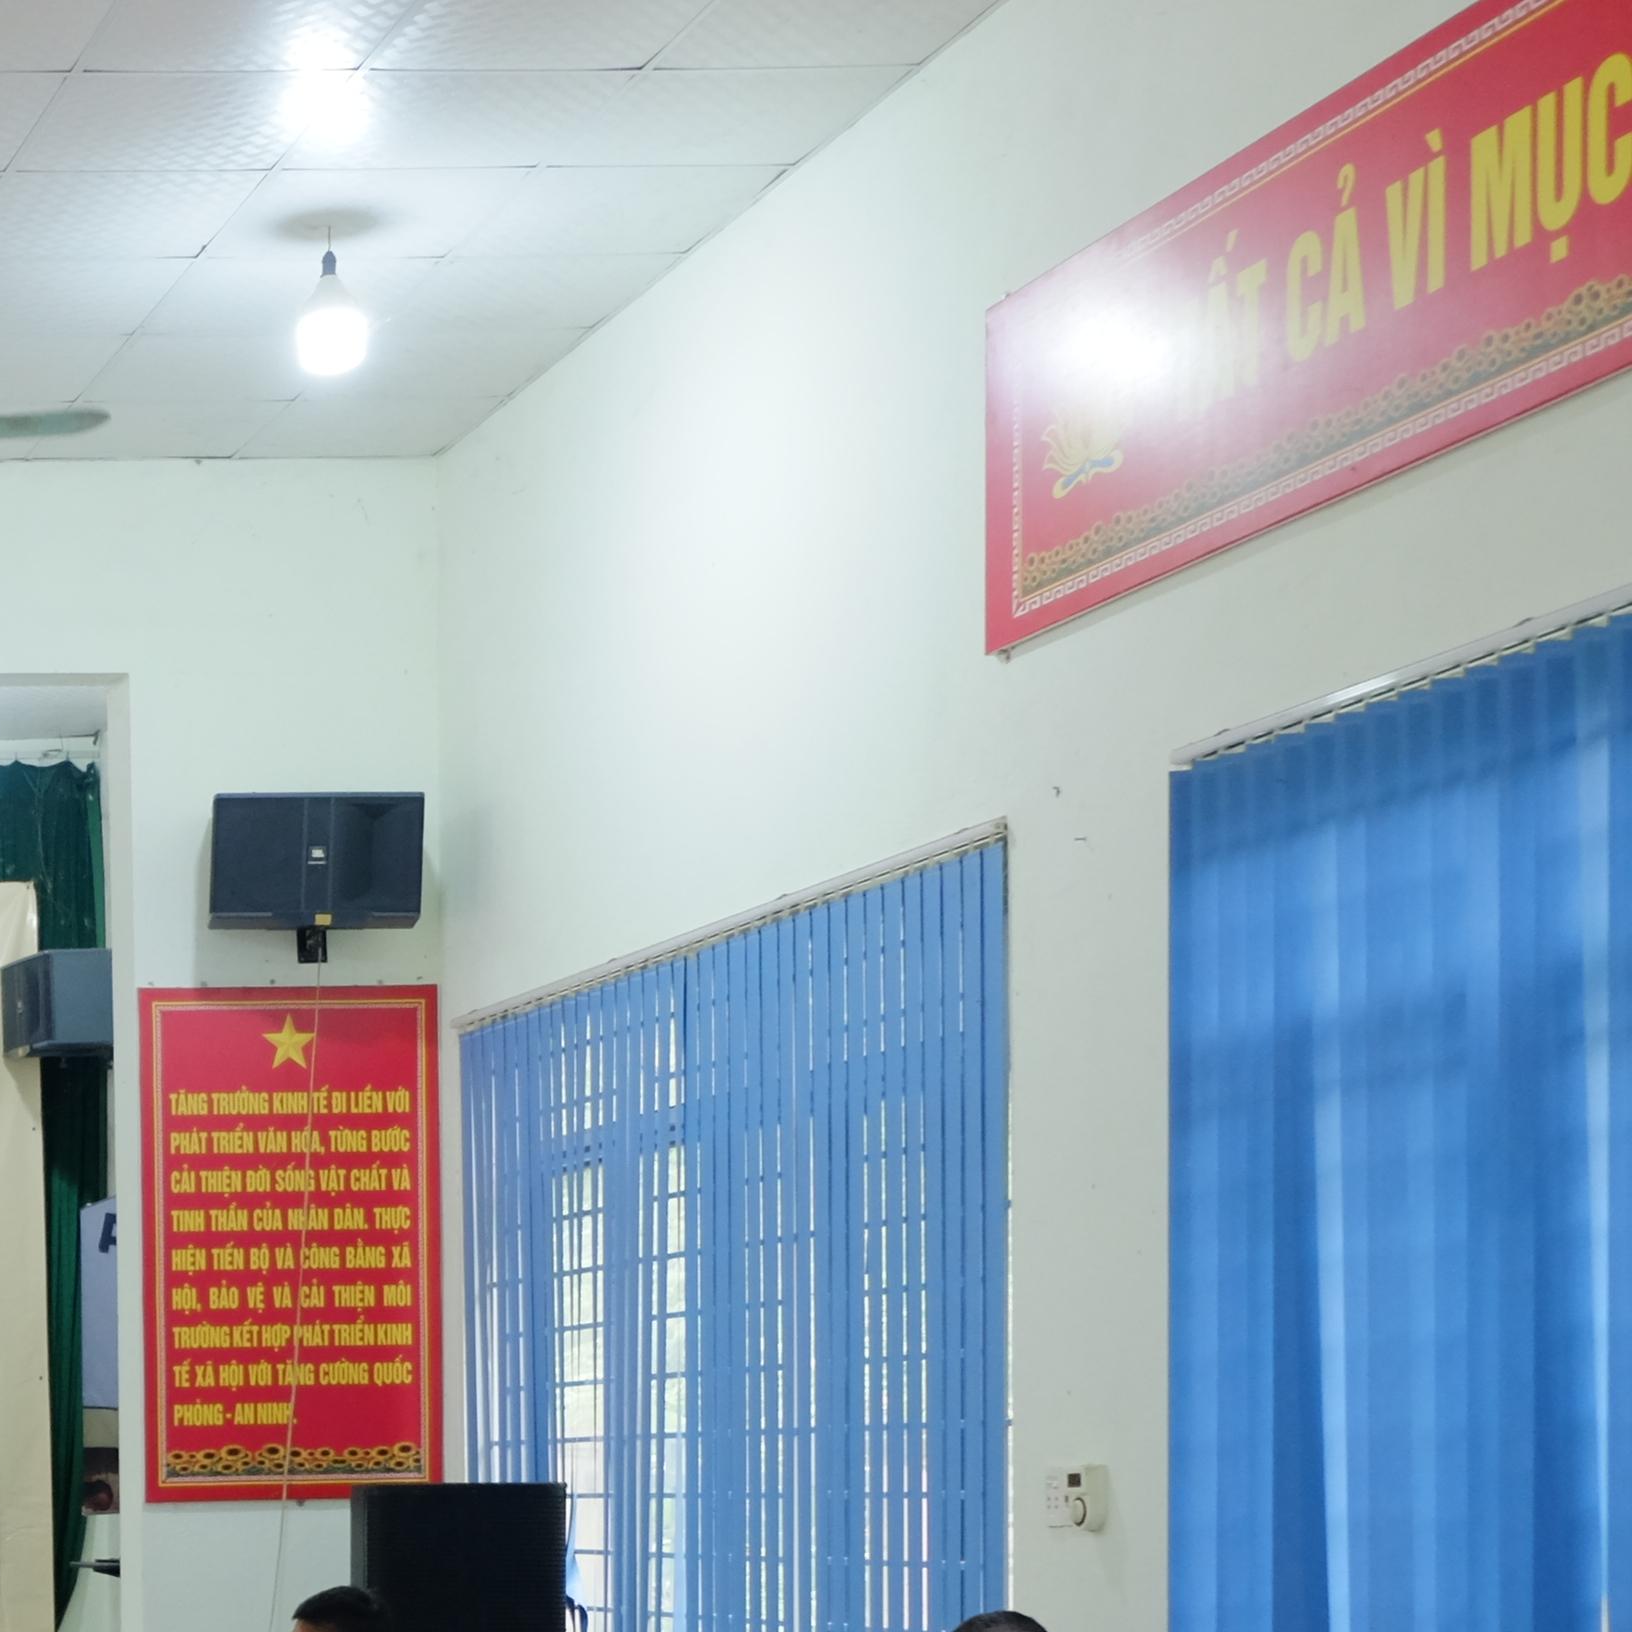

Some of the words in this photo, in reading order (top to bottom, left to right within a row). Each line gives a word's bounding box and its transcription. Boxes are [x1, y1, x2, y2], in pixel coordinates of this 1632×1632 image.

[1171, 229, 1267, 418] ẤT
[1286, 164, 1366, 362] CẢ
[1386, 129, 1447, 310] VÌ
[170, 1089, 208, 1115] TĂNG
[211, 1086, 268, 1115] TRƯỞNG
[273, 1092, 311, 1116] KINH
[313, 1086, 329, 1113] TẾ
[331, 1092, 346, 1113] ĐI
[350, 1086, 382, 1113] LIỀN
[386, 1088, 409, 1112] VỚI
[170, 1128, 207, 1154] PHÁT
[211, 1123, 253, 1153] TRIỂN
[258, 1128, 287, 1152] VĂN
[291, 1125, 325, 1155] HÓA,
[329, 1127, 367, 1152] TỪNG
[371, 1126, 410, 1152] BƯỚC
[171, 1165, 195, 1193] CẢI
[200, 1167, 242, 1196] THIỆN
[246, 1166, 270, 1192] ĐỜI
[275, 1162, 315, 1195] SỐNG
[320, 1165, 345, 1195] VẬT
[350, 1165, 387, 1190] CHẤT
[392, 1165, 411, 1190] VÀ
[171, 1210, 205, 1231] TINH
[209, 1203, 248, 1231] THẦN
[253, 1203, 283, 1230] CỦA
[288, 1205, 328, 1231] NHÂN
[334, 1204, 368, 1229] DÂN.
[374, 1206, 410, 1233] THỰC
[172, 1245, 206, 1274] HIỆN
[211, 1242, 244, 1270] TIẾN
[250, 1244, 269, 1273] BỘ
[276, 1244, 294, 1269] VÀ
[301, 1238, 340, 1268] CÔNG
[345, 1239, 385, 1268] BẰNG
[392, 1242, 411, 1267] XÃ
[172, 1284, 201, 1313] HỘI,
[209, 1281, 238, 1309] BẢO
[247, 1283, 265, 1312] VỆ
[273, 1283, 292, 1307] VÀ
[300, 1280, 324, 1307] CẢI
[332, 1282, 375, 1310] THIỆN
[383, 1281, 411, 1306] MÔI
[173, 1322, 230, 1348] TRƯỜNG
[233, 1320, 259, 1347] KẾT
[261, 1324, 291, 1351] HỢP
[294, 1321, 330, 1348] PHÁT
[332, 1315, 375, 1345] TRIỂN
[377, 1324, 412, 1345] KINH
[173, 1362, 190, 1387] TẾ
[195, 1362, 214, 1386] XÃ
[219, 1361, 244, 1390] HỘI
[249, 1360, 272, 1385] VỚI
[277, 1361, 314, 1386] TĂNG
[319, 1359, 368, 1384] CƯỜNG
[374, 1355, 412, 1385] QUỐC
[174, 1404, 223, 1425] PHÒNG
[234, 1404, 254, 1424] AN
